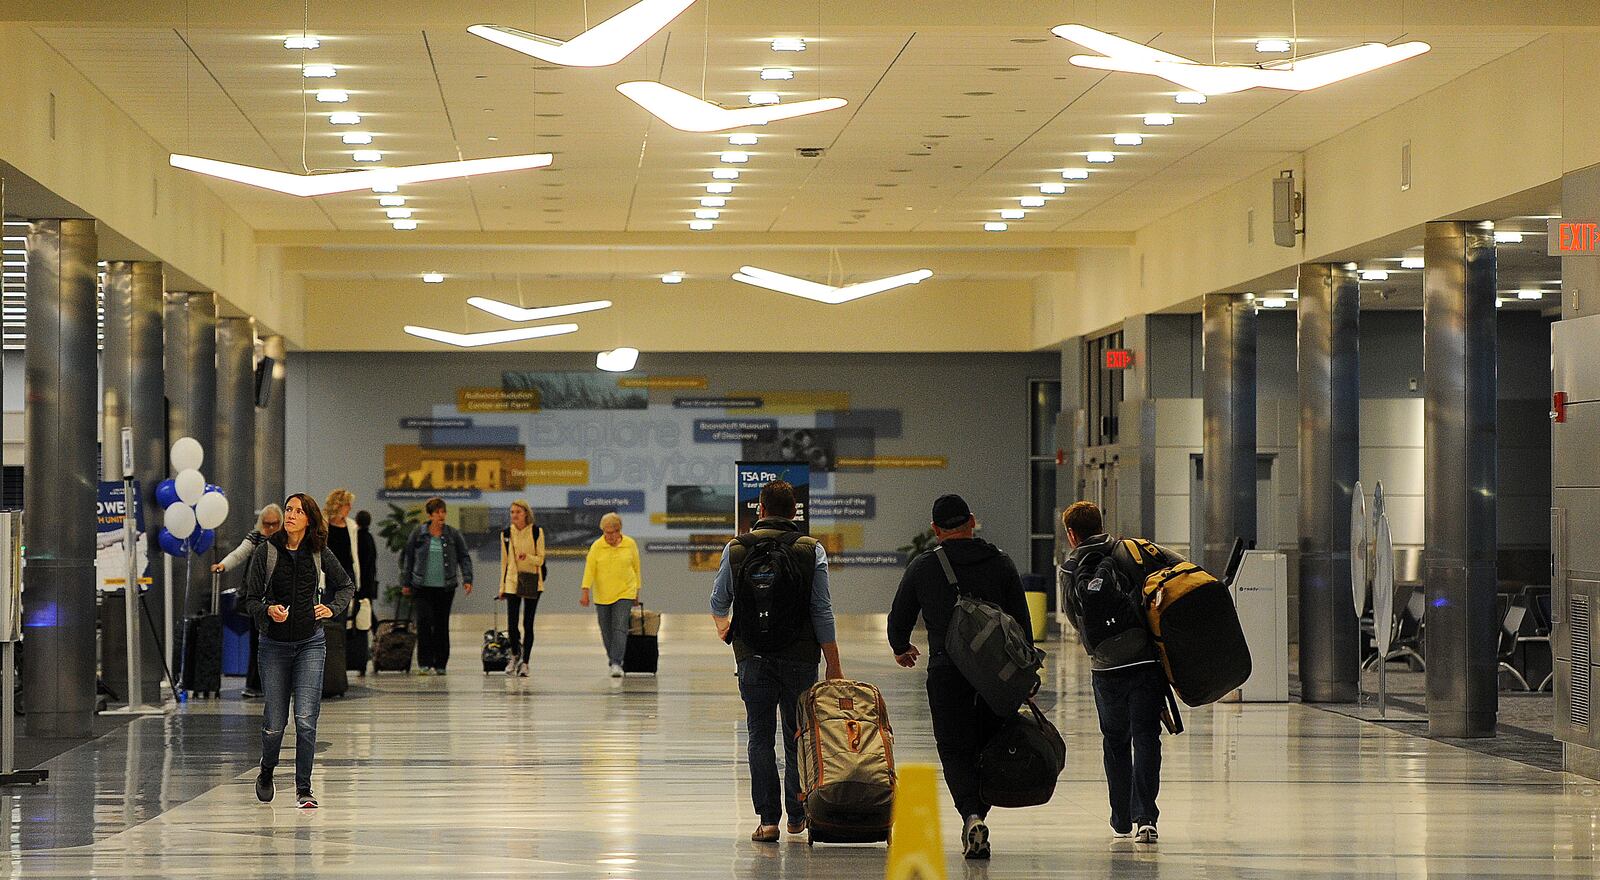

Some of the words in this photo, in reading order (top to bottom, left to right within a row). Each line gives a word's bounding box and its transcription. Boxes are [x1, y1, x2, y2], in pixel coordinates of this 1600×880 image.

[1559, 223, 1597, 251] EXIT
[1106, 351, 1127, 369] EXIT
[739, 422, 770, 431] Museum
[530, 412, 681, 457] Explore
[721, 432, 758, 441] Discovery
[511, 468, 537, 478] Dayton
[552, 468, 583, 477] Institute
[591, 448, 735, 492] Dayton
[741, 472, 760, 481] TSA
[760, 472, 777, 481] Pre
[583, 497, 608, 506] Carillon
[609, 498, 629, 506] Park
[812, 497, 843, 505] Museum
[854, 497, 866, 505] the
[844, 508, 865, 516] Force
[832, 555, 855, 564] Rivers
[855, 555, 897, 564] MetroParks
